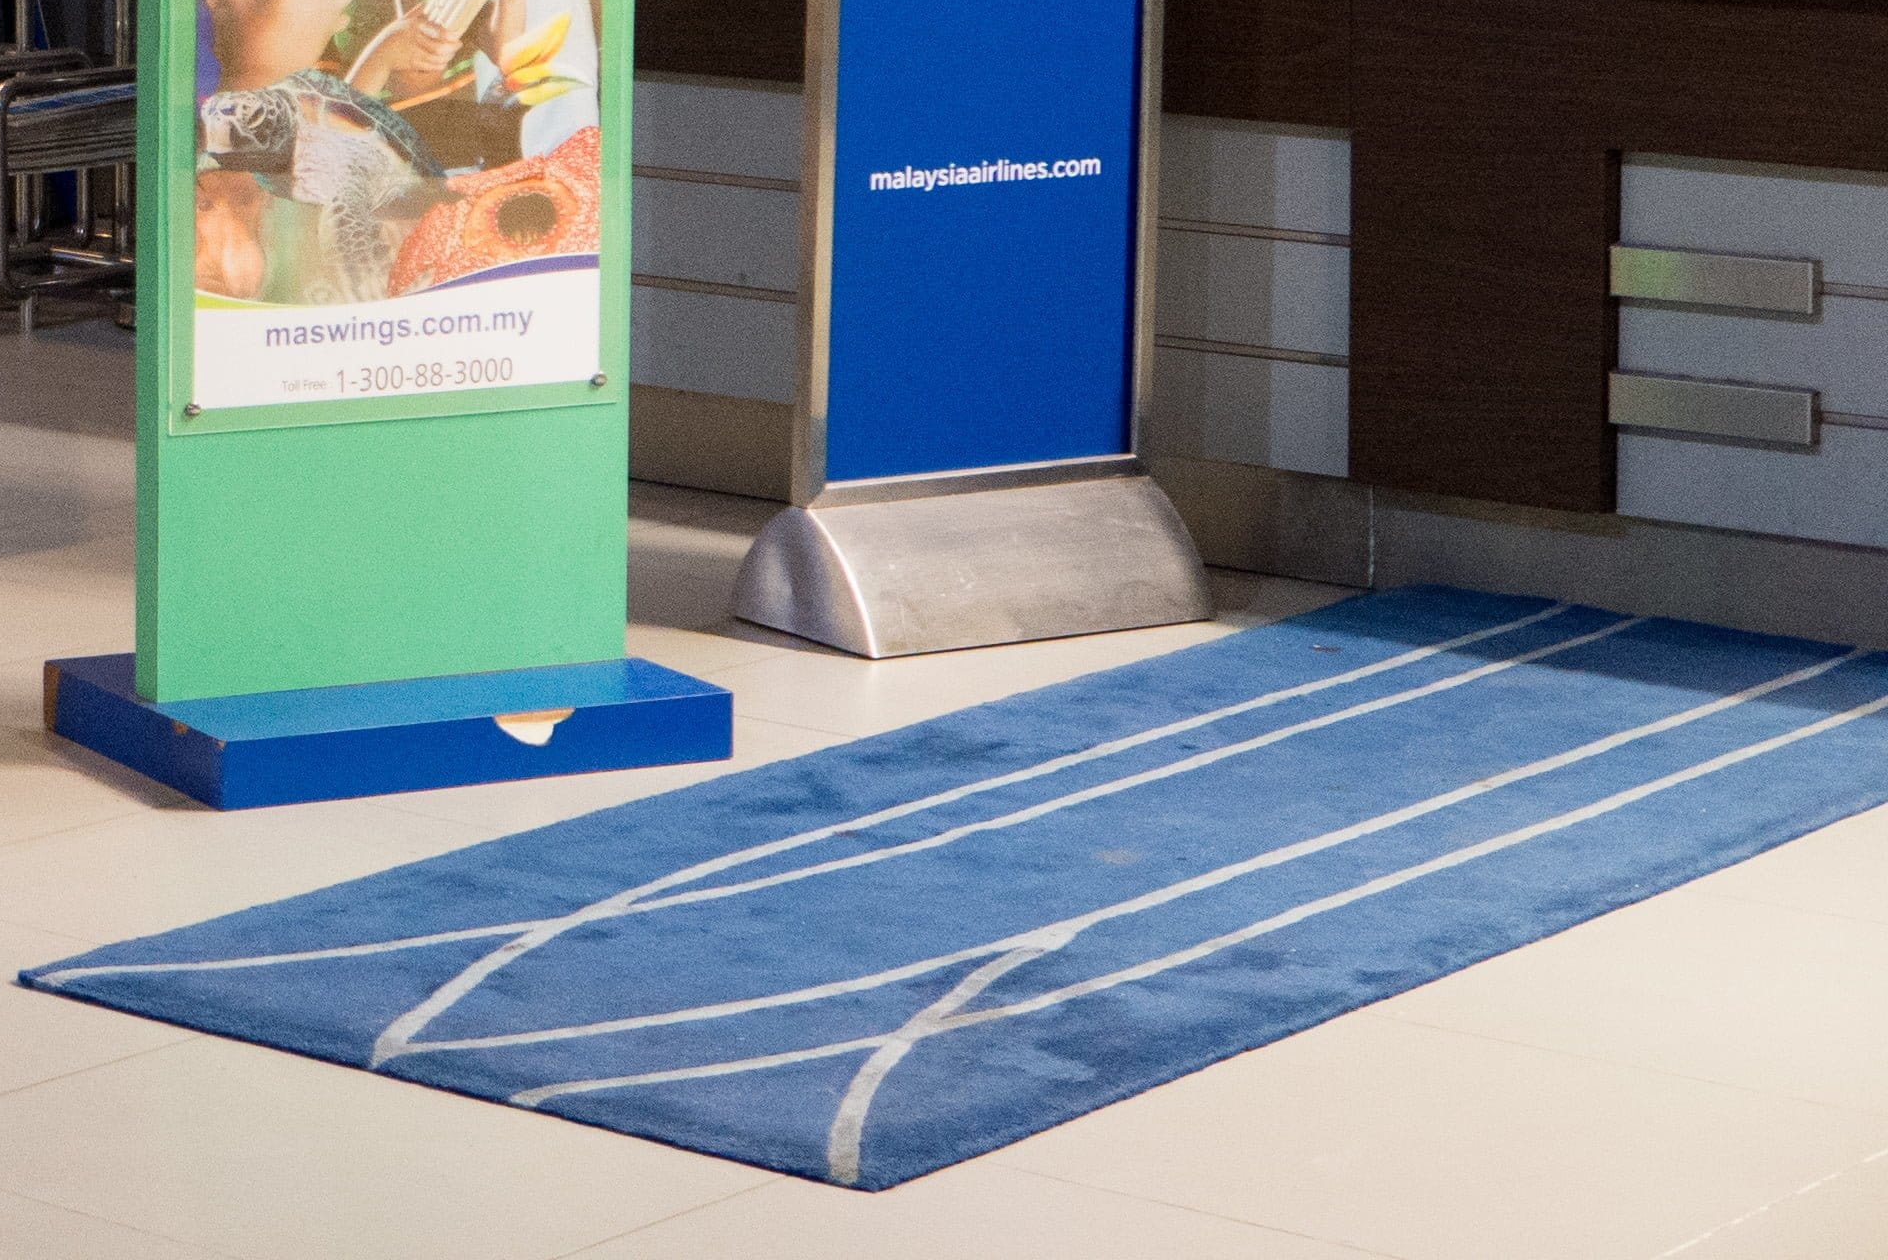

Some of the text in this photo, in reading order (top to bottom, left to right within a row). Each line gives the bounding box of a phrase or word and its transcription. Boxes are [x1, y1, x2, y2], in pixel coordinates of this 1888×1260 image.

[870, 157, 1102, 192] malaysiaairlines.com
[265, 310, 534, 347] maswings.com.my
[282, 379, 300, 392] Toll
[335, 357, 514, 394] 1-300-88-3000
